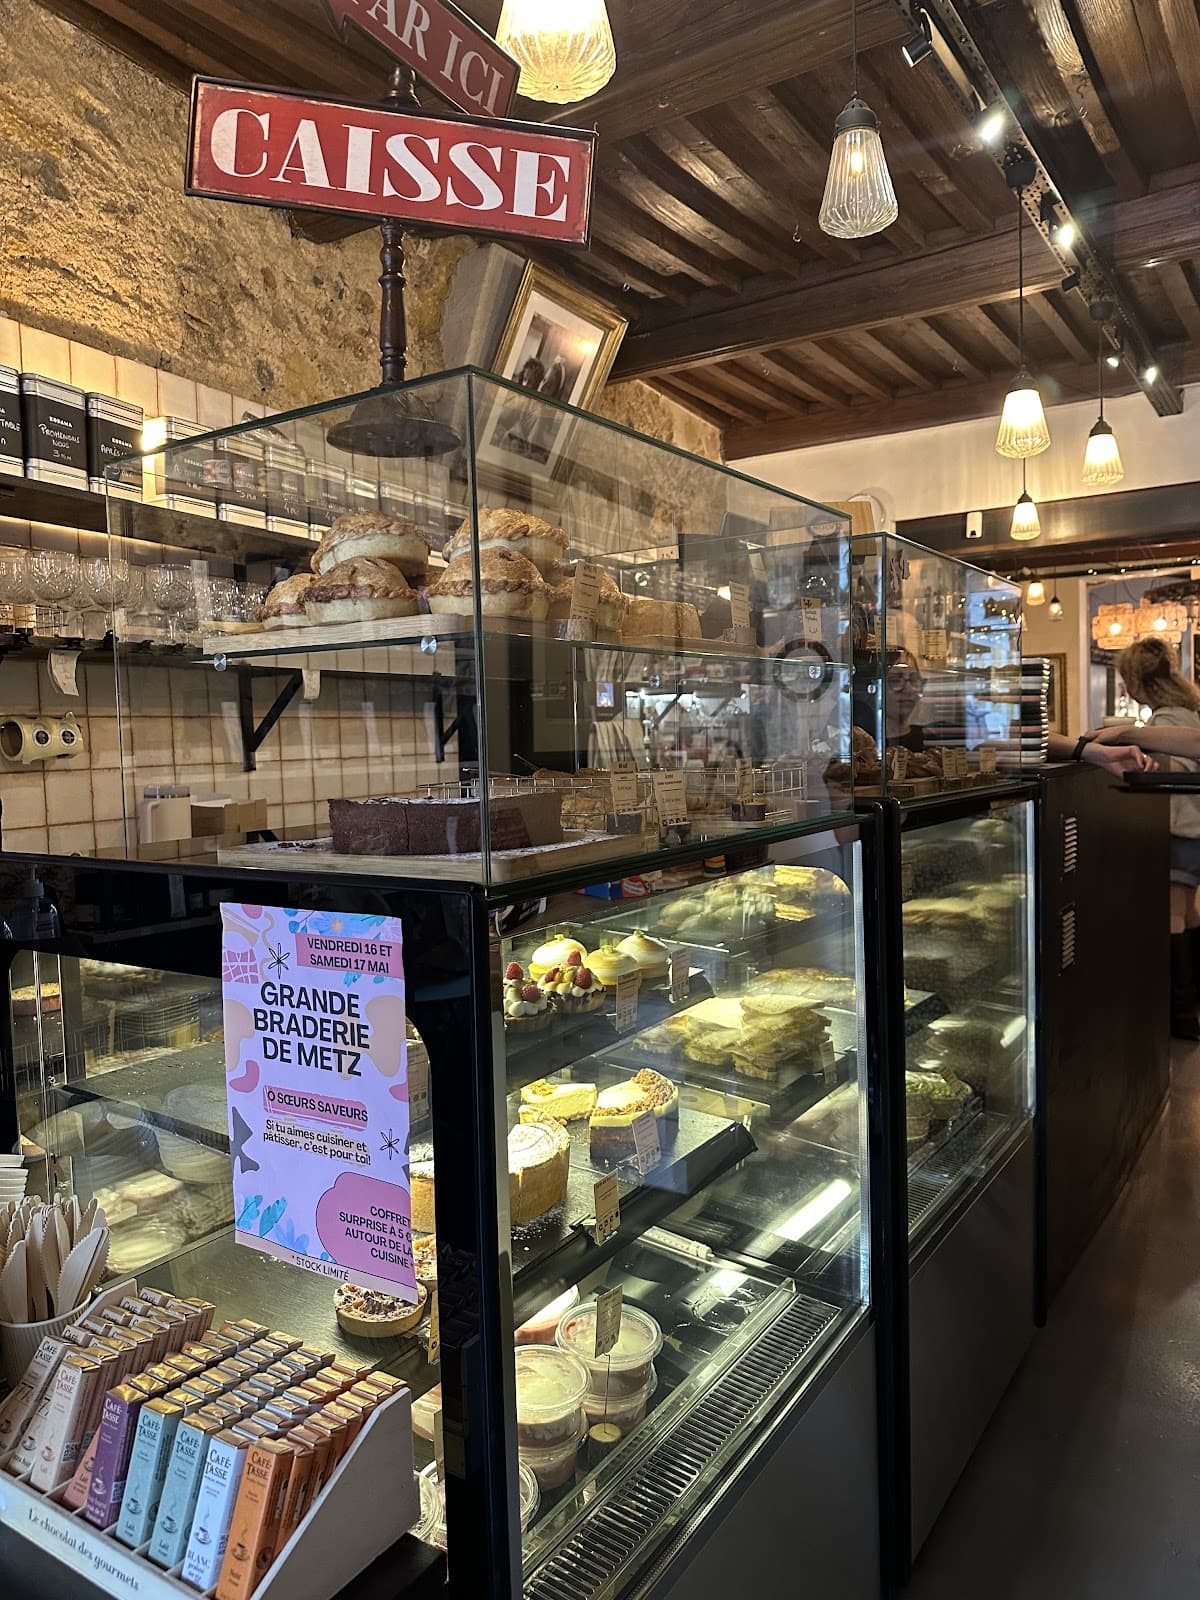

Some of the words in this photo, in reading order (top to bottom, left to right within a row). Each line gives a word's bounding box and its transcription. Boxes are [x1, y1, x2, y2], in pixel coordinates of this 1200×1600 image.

[352, 0, 430, 61] AR
[440, 30, 504, 116] ICI
[210, 108, 570, 221] CAISSE
[307, 937, 362, 954] VENDREDI
[364, 944, 377, 955] 16
[380, 945, 392, 957] ET
[310, 954, 351, 969] SAMEDI
[354, 959, 365, 970] 17
[368, 960, 389, 973] MAI
[261, 981, 360, 1018] GRANDE
[253, 1008, 370, 1049] BRADERIE
[263, 1037, 292, 1064] DE
[297, 1042, 362, 1077] METZ
[277, 1092, 316, 1110] SŒURS
[317, 1100, 369, 1122] SAVEURS
[266, 1119, 274, 1130] Si
[275, 1122, 286, 1132] tu
[287, 1125, 315, 1140] aimes
[316, 1133, 354, 1149] cuisiner
[356, 1142, 367, 1152] et
[330, 1148, 353, 1160] pour
[339, 1211, 387, 1234] SURPRISE
[398, 1229, 404, 1239] 5
[370, 1206, 411, 1227] COFFRET
[345, 1227, 387, 1248] AUTOUR
[389, 1239, 402, 1252] DE
[403, 1244, 413, 1258] LA
[370, 1248, 410, 1269] CUISINE
[323, 1265, 350, 1281] LIMITÉ
[138, 1424, 157, 1441] TASSE
[176, 1441, 196, 1458] TASSE
[204, 1462, 229, 1480] TASSE
[247, 1462, 268, 1479] TASSE
[28, 1507, 40, 1522] Le
[40, 1517, 77, 1550] chocolat
[78, 1542, 94, 1560] des
[93, 1554, 139, 1591] gourmets
